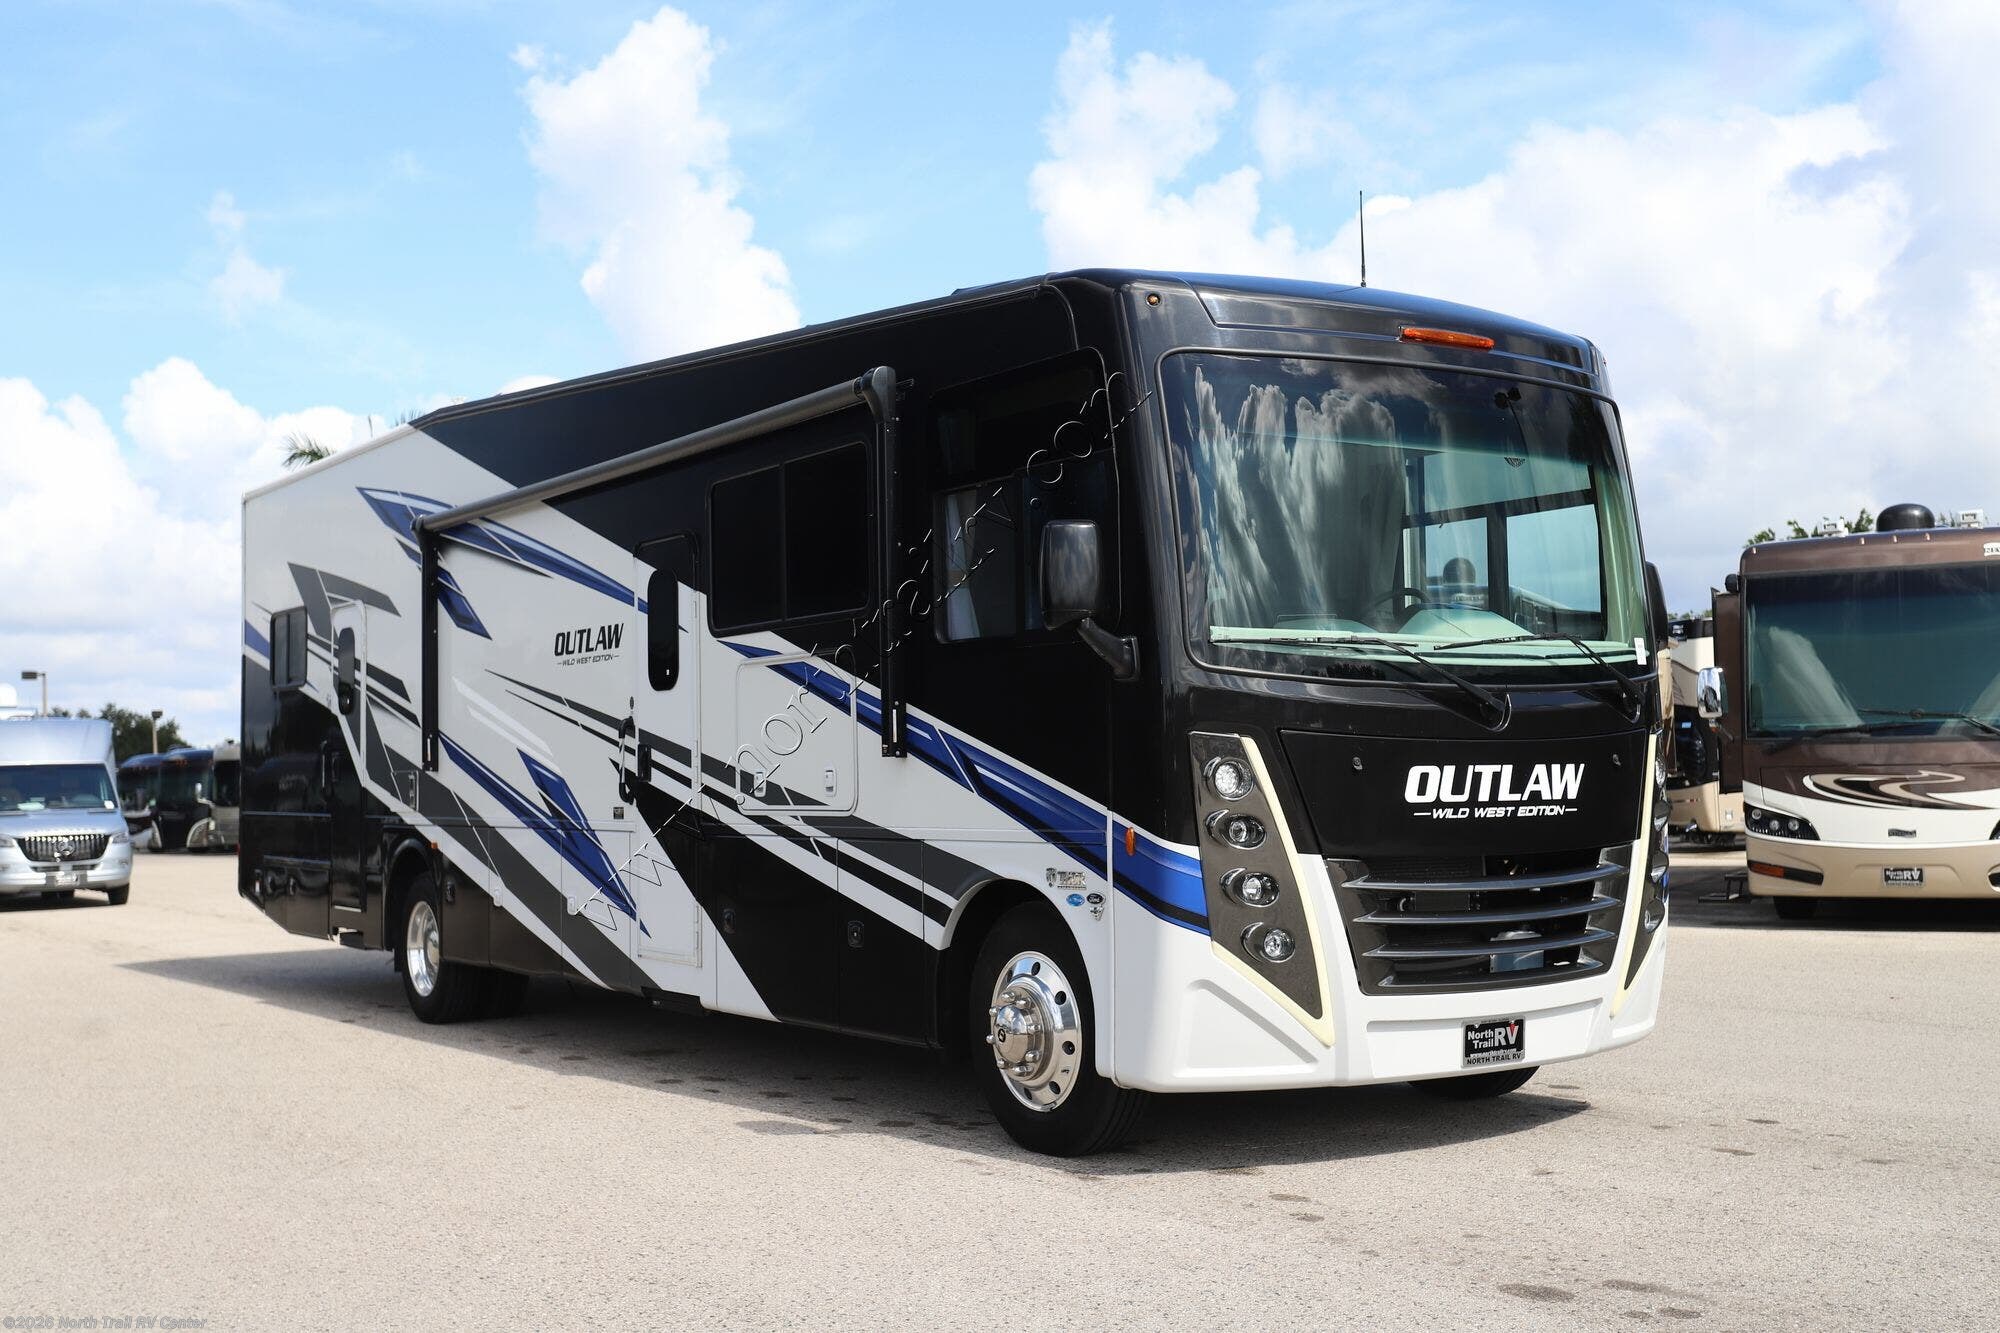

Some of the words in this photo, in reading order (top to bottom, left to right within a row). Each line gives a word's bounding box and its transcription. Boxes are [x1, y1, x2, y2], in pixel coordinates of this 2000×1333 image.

[554, 623, 624, 656] OUTLAW
[1404, 763, 1585, 804] OUTLAW
[1432, 807, 1470, 819] WILD
[1474, 806, 1516, 819] WEST
[1517, 804, 1566, 817] EDITION
[1467, 1029, 1494, 1040] North
[1494, 1024, 1519, 1047] RV
[1472, 1038, 1494, 1049] Trail
[1467, 1056, 1490, 1064] NORTH
[1492, 1054, 1511, 1062] TRAIL
[1512, 1052, 1521, 1060] RV
